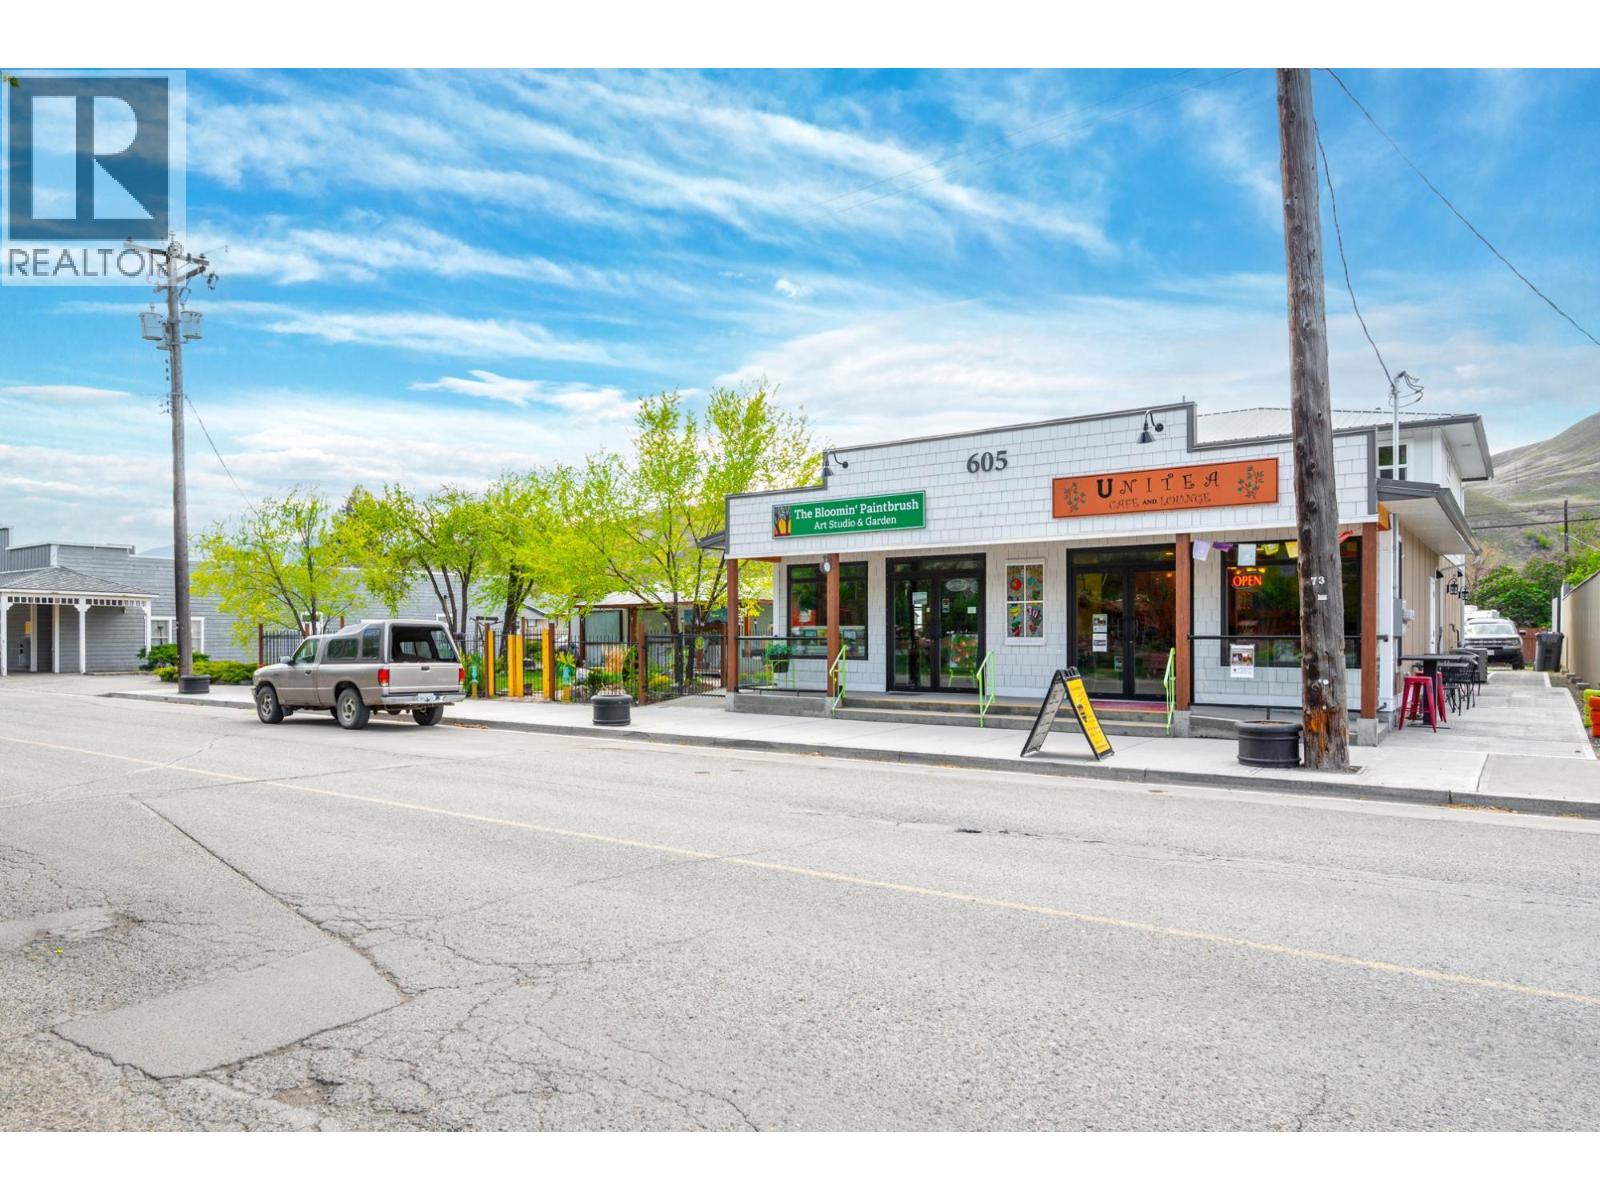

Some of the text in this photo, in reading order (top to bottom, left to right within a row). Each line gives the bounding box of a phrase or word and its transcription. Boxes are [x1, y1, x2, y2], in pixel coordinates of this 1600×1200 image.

[967, 450, 1008, 474] 605
[1096, 471, 1220, 499] UNITEA
[1160, 492, 1212, 507] LOUNGE
[794, 499, 919, 520] The Bloomin' Paintbrush
[814, 515, 897, 530] Art Studio & Garden
[1232, 575, 1262, 586] OPEN
[1311, 576, 1325, 585] 73
